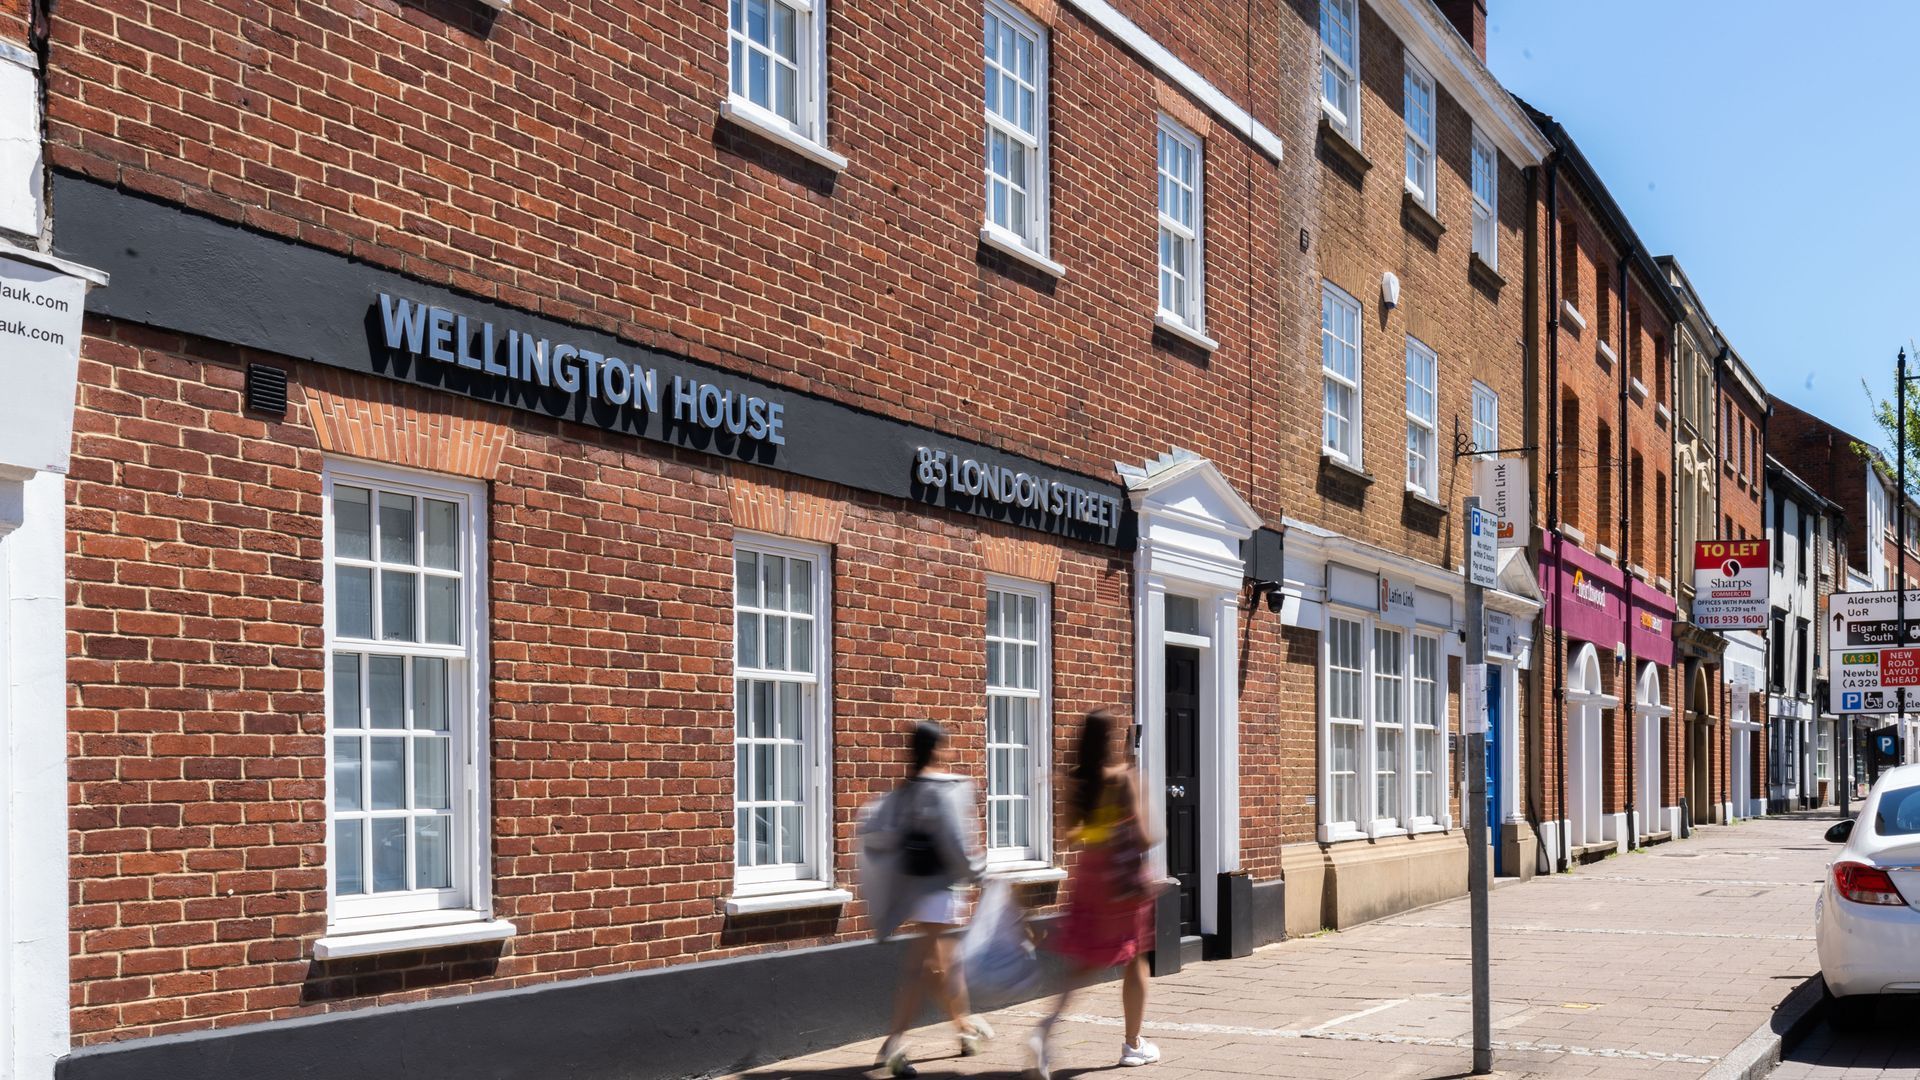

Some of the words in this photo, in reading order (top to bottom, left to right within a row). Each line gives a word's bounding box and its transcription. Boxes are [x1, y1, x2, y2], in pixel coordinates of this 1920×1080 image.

[377, 292, 658, 414] WELLINGTON
[671, 375, 786, 446] HOUSE
[1495, 463, 1506, 487] Link
[916, 446, 947, 488] 85
[951, 454, 1049, 513] LONDON
[1050, 481, 1120, 529] STREET
[1495, 490, 1506, 518] Latin
[1701, 543, 1725, 557] TO
[1730, 543, 1760, 557] LET
[1711, 578, 1752, 590] Sharps
[1389, 586, 1402, 605] Latin
[1403, 588, 1415, 608] Link
[1847, 594, 1898, 605] Aldershot
[1847, 608, 1869, 617] UoR
[1698, 616, 1720, 624] 0118
[1722, 615, 1739, 624] 939
[1742, 615, 1764, 623] 1600
[1850, 624, 1876, 634] Elgar
[1863, 632, 1894, 642] South
[1890, 651, 1912, 659] NEW
[1888, 659, 1915, 668] ROAD
[1883, 667, 1919, 676] LAYOUT
[1885, 675, 1918, 684] AHEAD
[1886, 700, 1920, 709] Orcle
